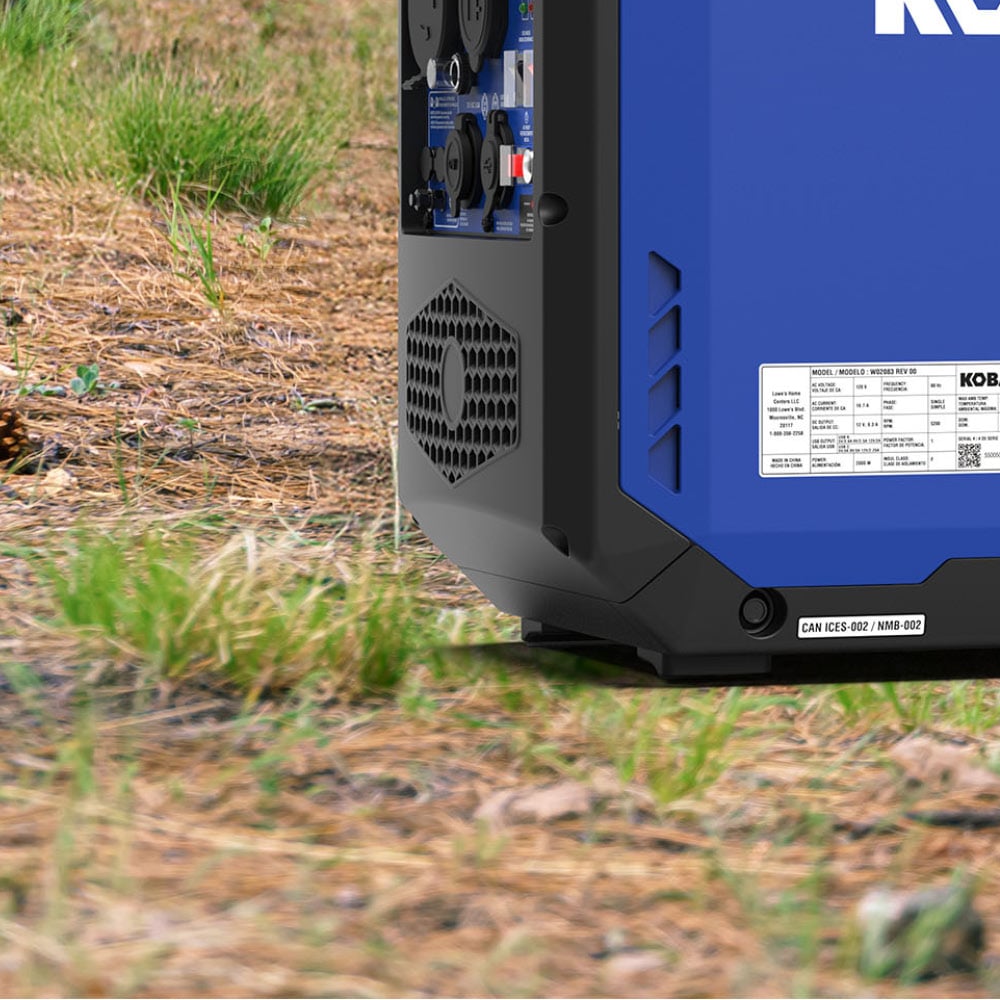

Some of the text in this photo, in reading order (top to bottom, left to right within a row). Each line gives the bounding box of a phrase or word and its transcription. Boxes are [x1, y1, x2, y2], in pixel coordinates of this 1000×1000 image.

[802, 623, 821, 632] CAN
[825, 621, 868, 632] ICES-002
[877, 620, 921, 630] NMB-002
